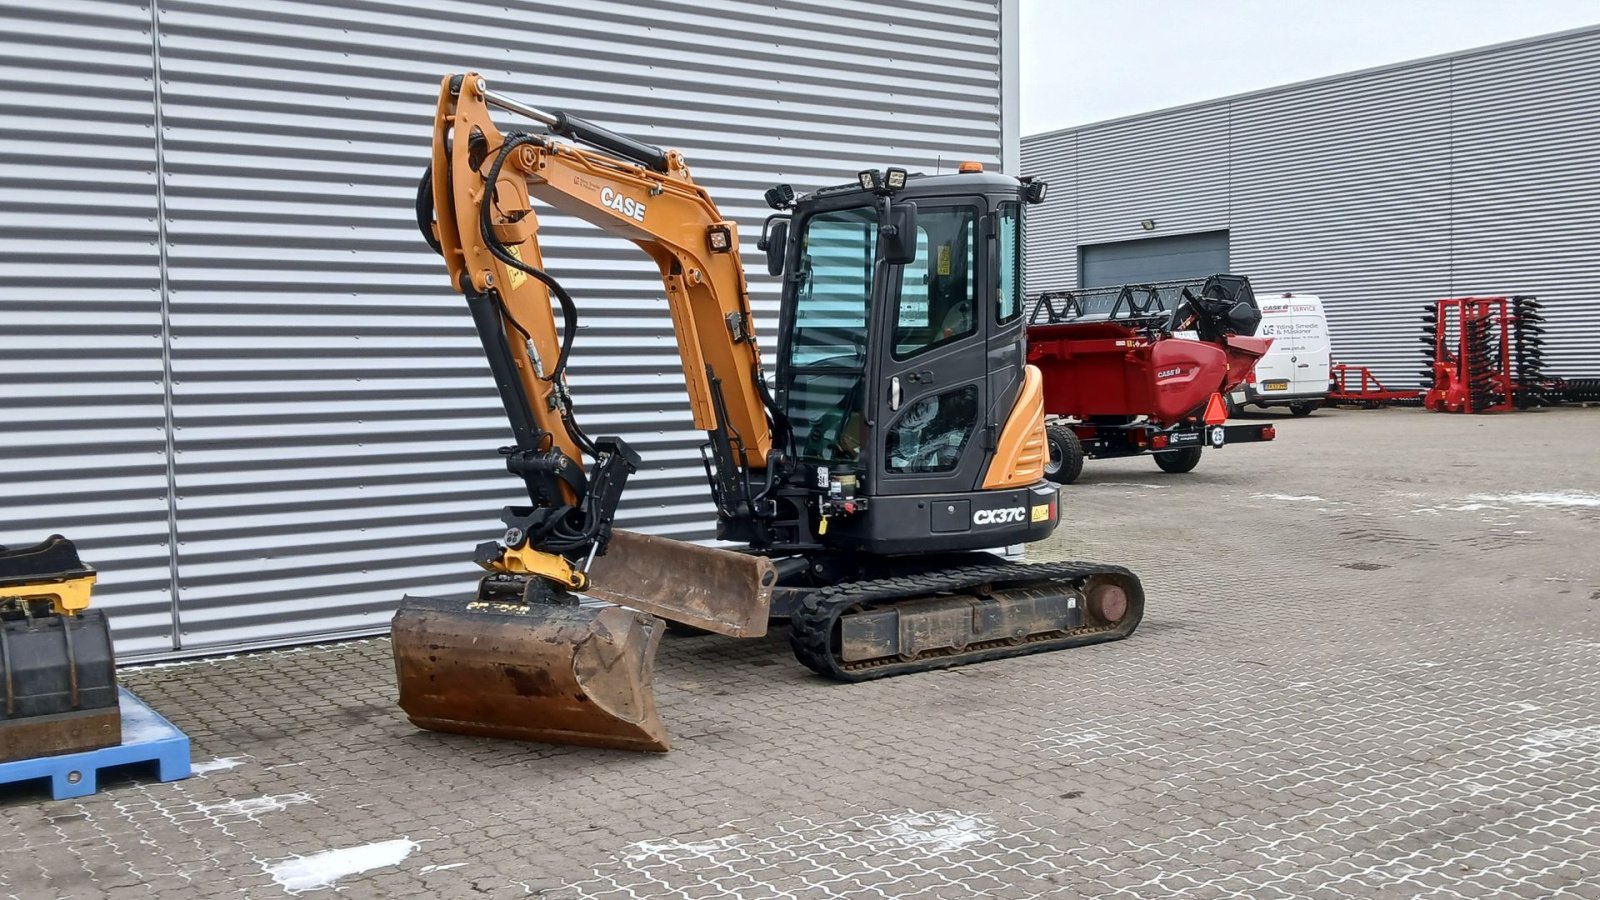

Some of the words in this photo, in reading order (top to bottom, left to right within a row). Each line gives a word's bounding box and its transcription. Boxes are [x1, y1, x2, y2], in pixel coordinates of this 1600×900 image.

[601, 186, 646, 222] CASE
[1157, 369, 1175, 378] CASE
[1213, 430, 1223, 442] 25
[973, 507, 1026, 525] CX37C
